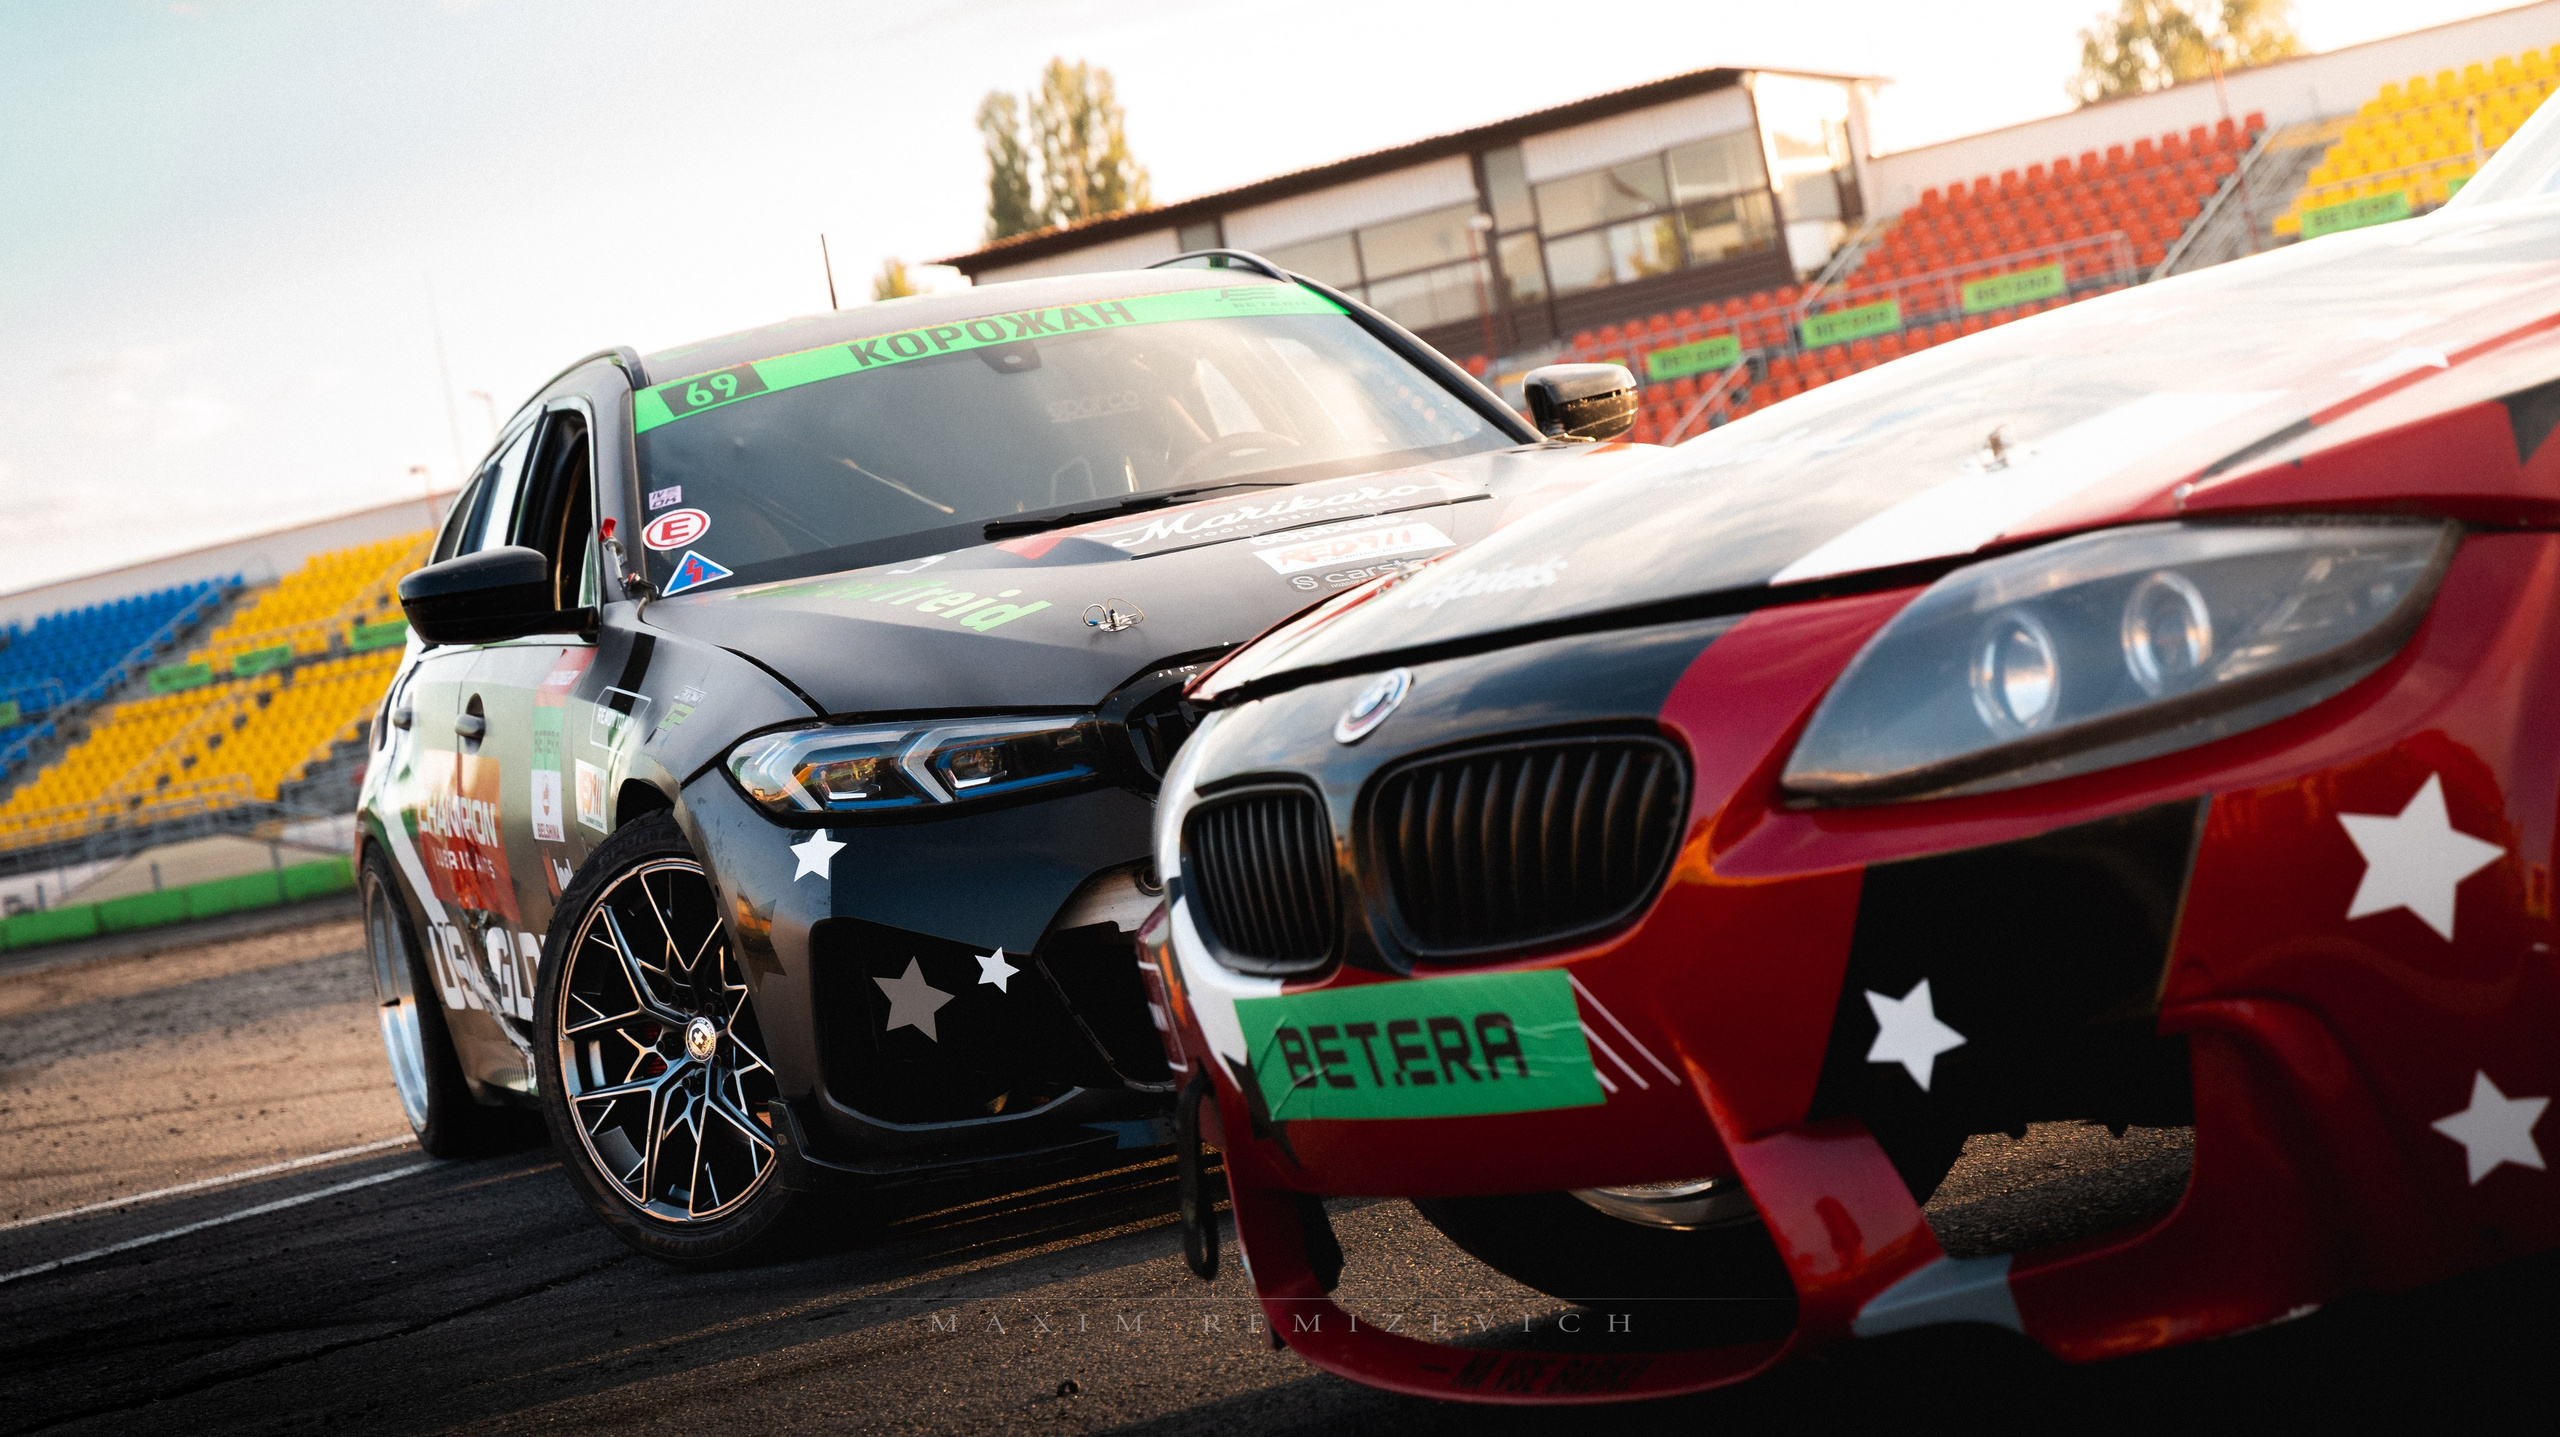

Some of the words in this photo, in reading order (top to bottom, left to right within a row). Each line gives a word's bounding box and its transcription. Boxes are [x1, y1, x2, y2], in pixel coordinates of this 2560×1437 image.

[848, 301, 1136, 367] КОРОЖАН
[686, 373, 738, 407] 69
[661, 517, 691, 541] E
[1095, 483, 1445, 549] Marikaro
[1275, 1012, 1529, 1089] BETERA
